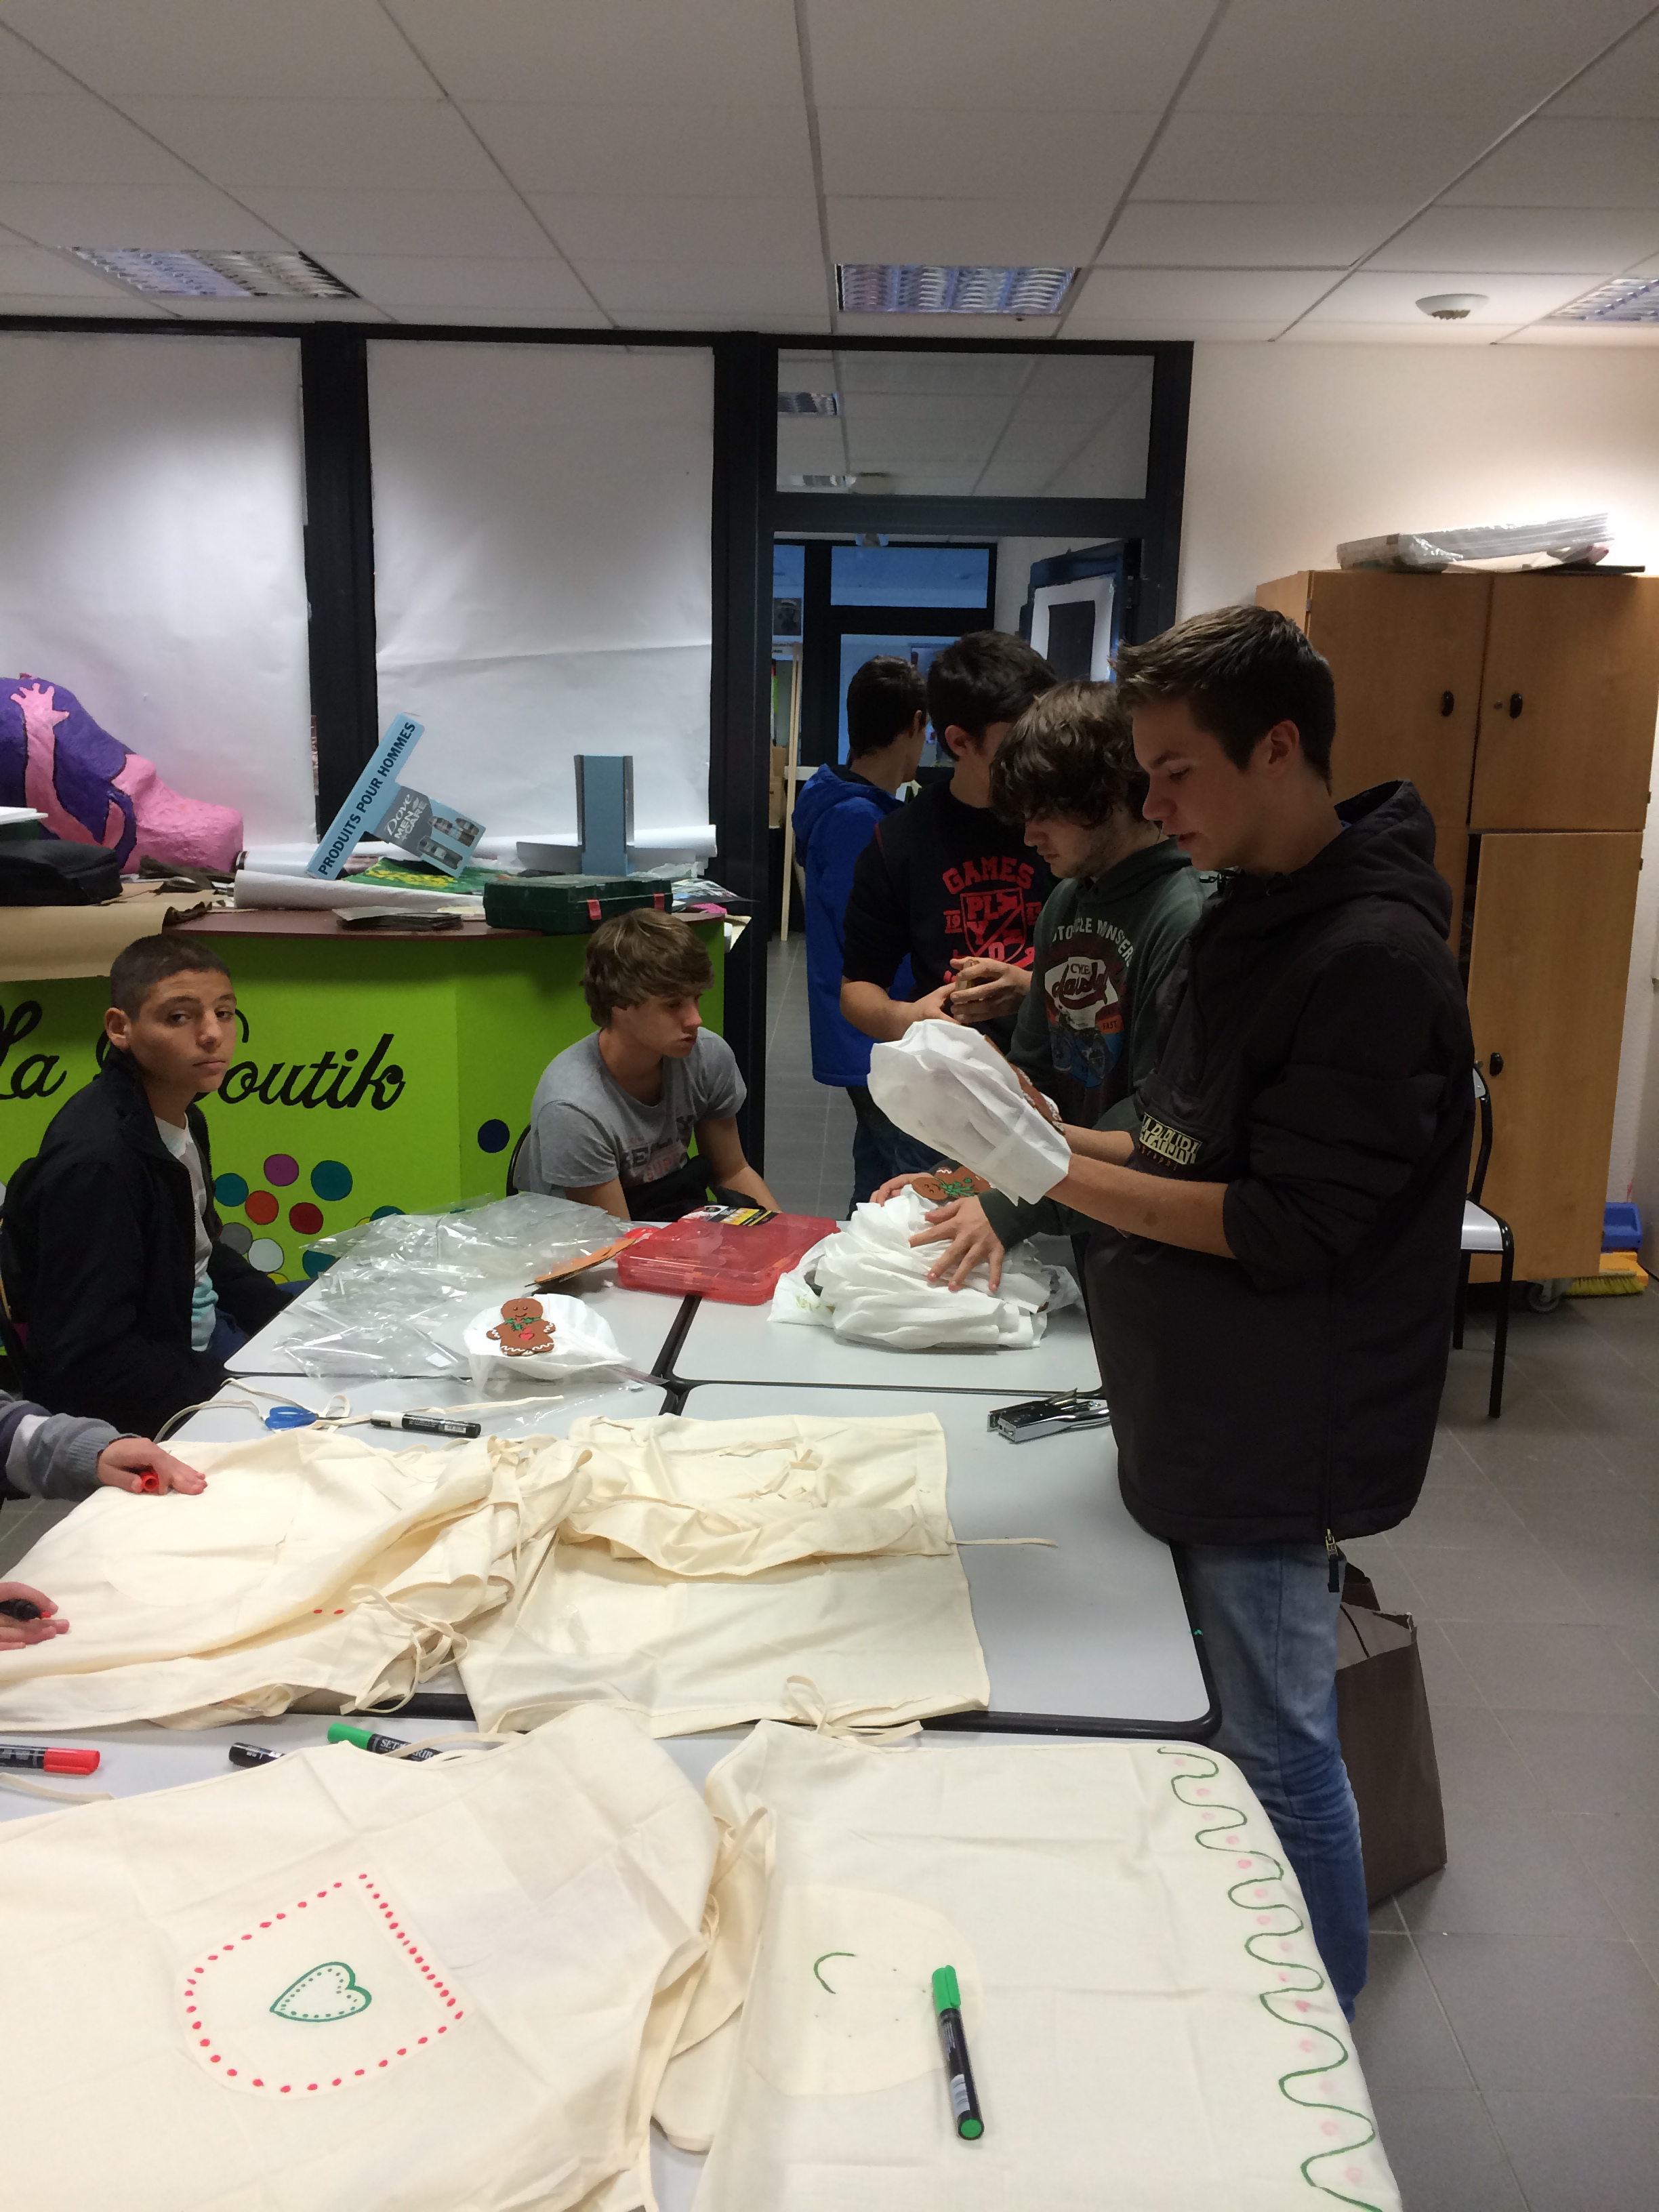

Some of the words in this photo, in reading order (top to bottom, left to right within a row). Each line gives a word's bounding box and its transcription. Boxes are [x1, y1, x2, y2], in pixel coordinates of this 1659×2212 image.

[318, 814, 361, 876] PRODUITS
[356, 777, 384, 813] POUR
[377, 722, 416, 777] HOMMES
[384, 794, 414, 836] Dove
[394, 811, 414, 839] MEN
[942, 856, 1035, 895] GAMES
[1103, 1019, 1118, 1030] EAST
